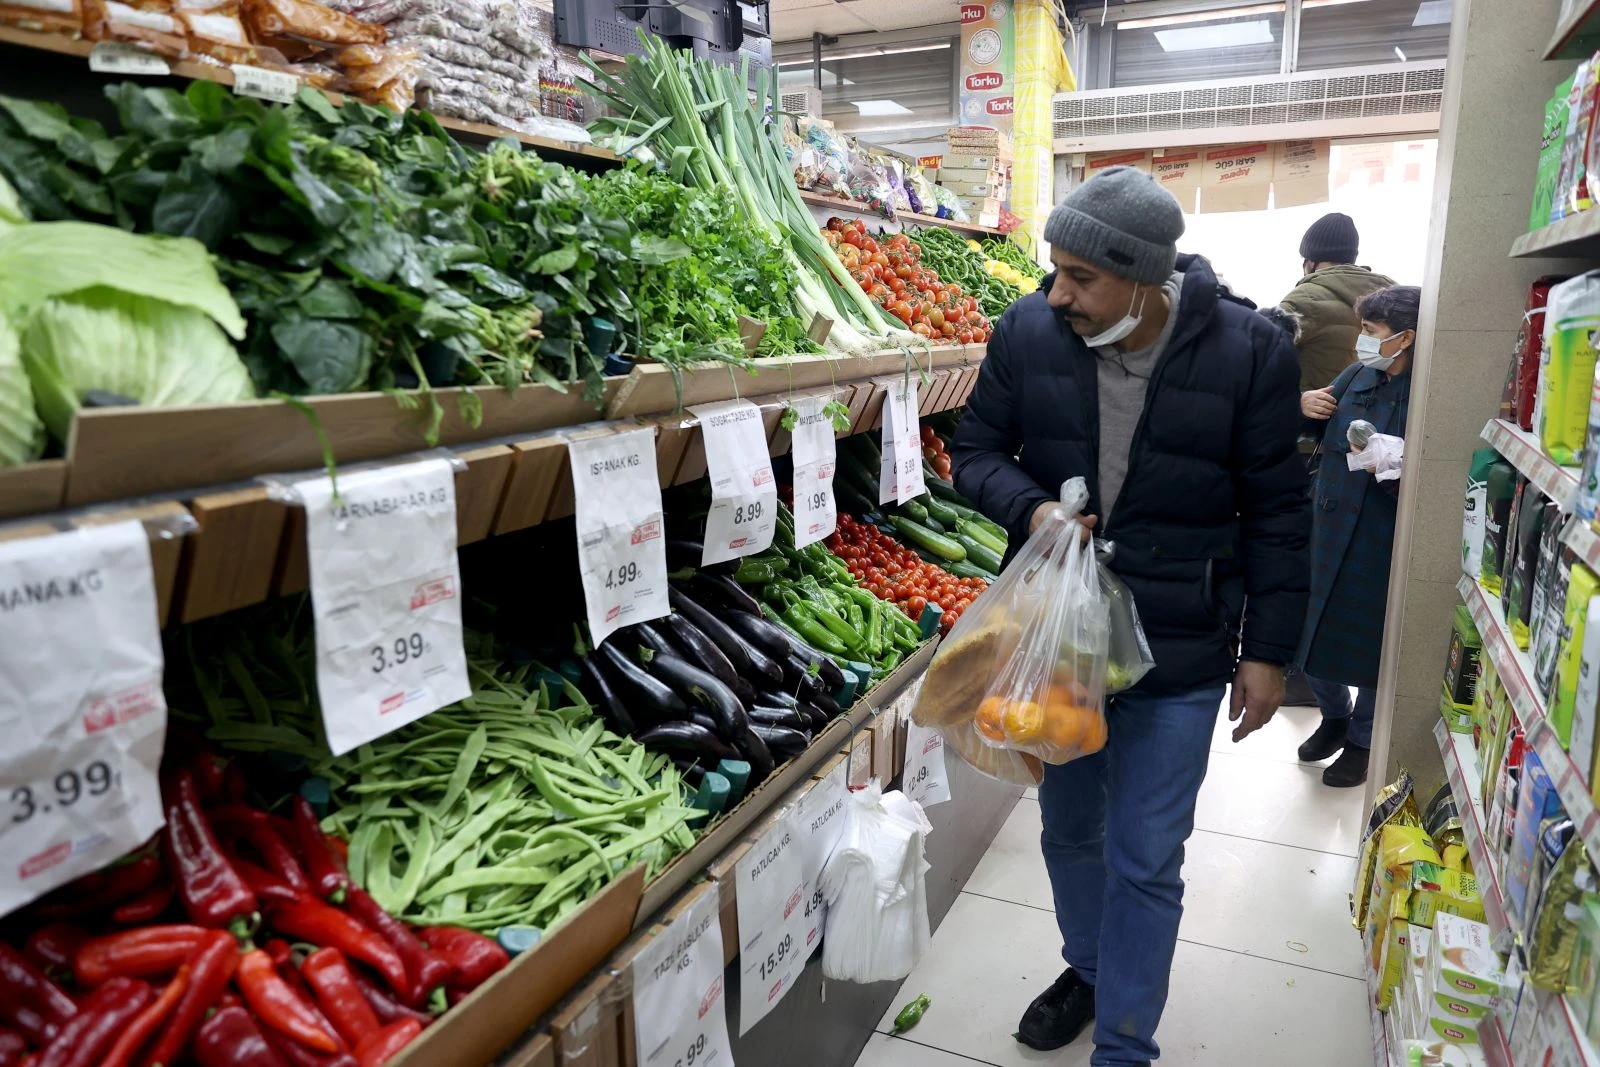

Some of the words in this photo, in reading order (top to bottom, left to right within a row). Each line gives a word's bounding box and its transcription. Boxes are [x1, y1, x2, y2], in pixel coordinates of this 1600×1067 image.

[960, 8, 981, 19] rku
[969, 75, 1000, 87] Torku
[1215, 160, 1234, 170] GÜÇ
[1235, 156, 1256, 166] SARI
[590, 457, 626, 476] ISPANAK
[370, 632, 424, 674] 3.99
[10, 759, 112, 824] 3.99
